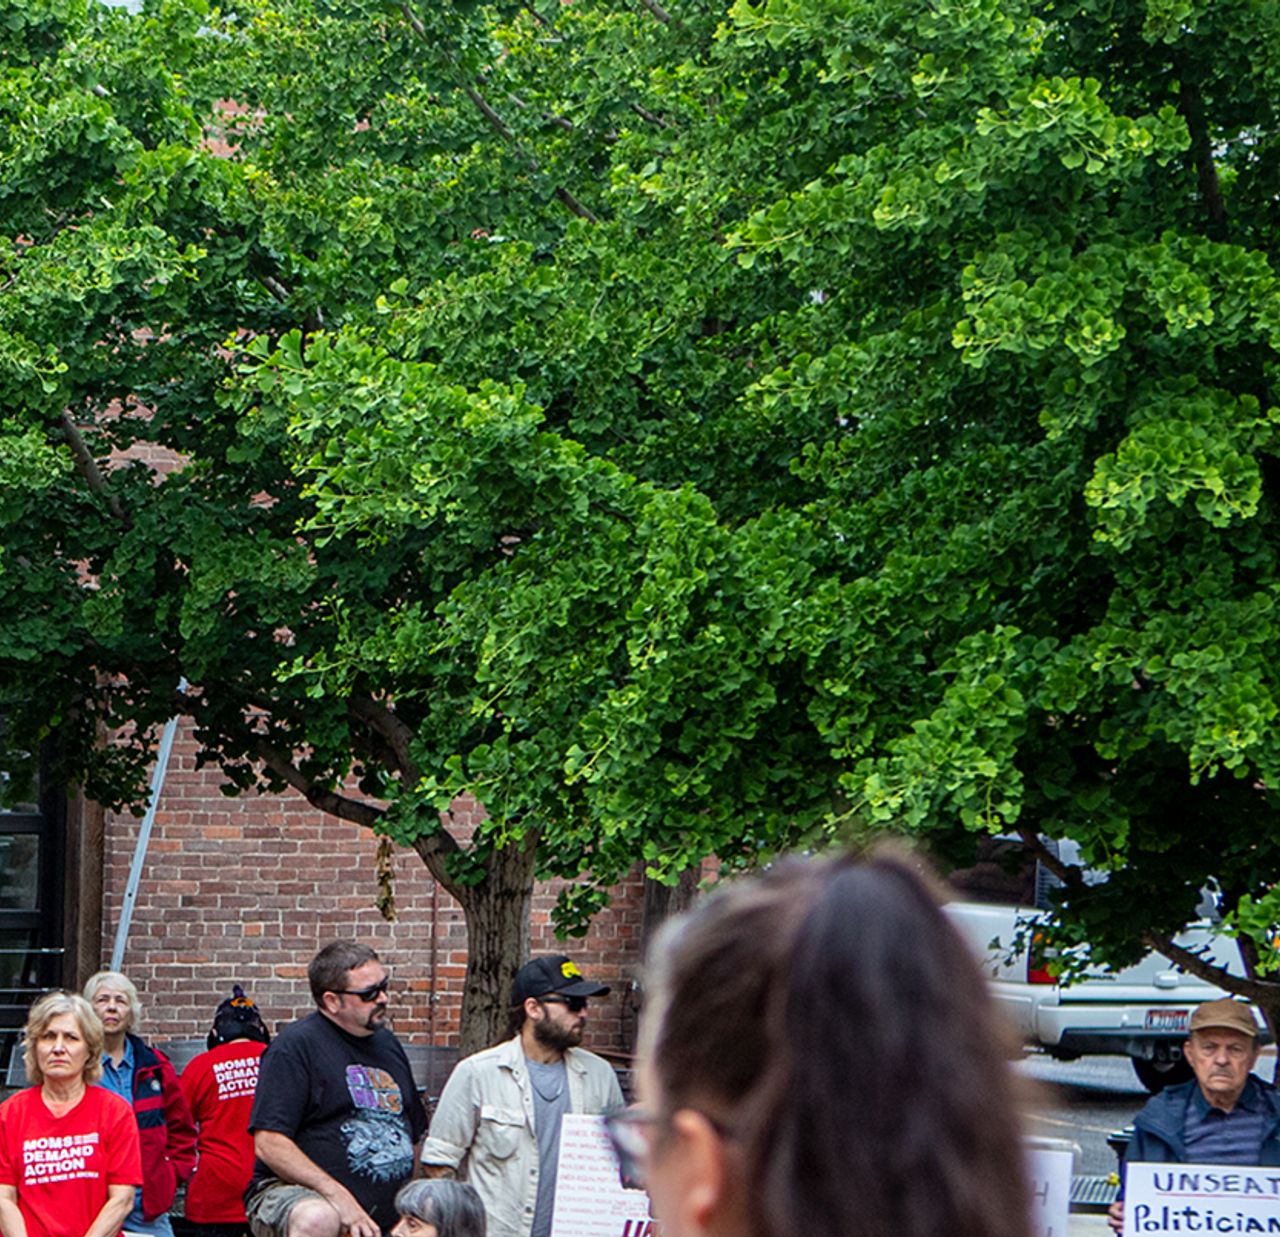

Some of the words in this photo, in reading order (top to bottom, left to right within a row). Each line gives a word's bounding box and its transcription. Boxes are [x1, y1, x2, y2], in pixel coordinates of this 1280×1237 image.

[218, 1077, 258, 1094] ACTIO
[23, 1136, 72, 1151] MOMS
[23, 1145, 94, 1164] DEMAND
[24, 1157, 85, 1177] ACTION
